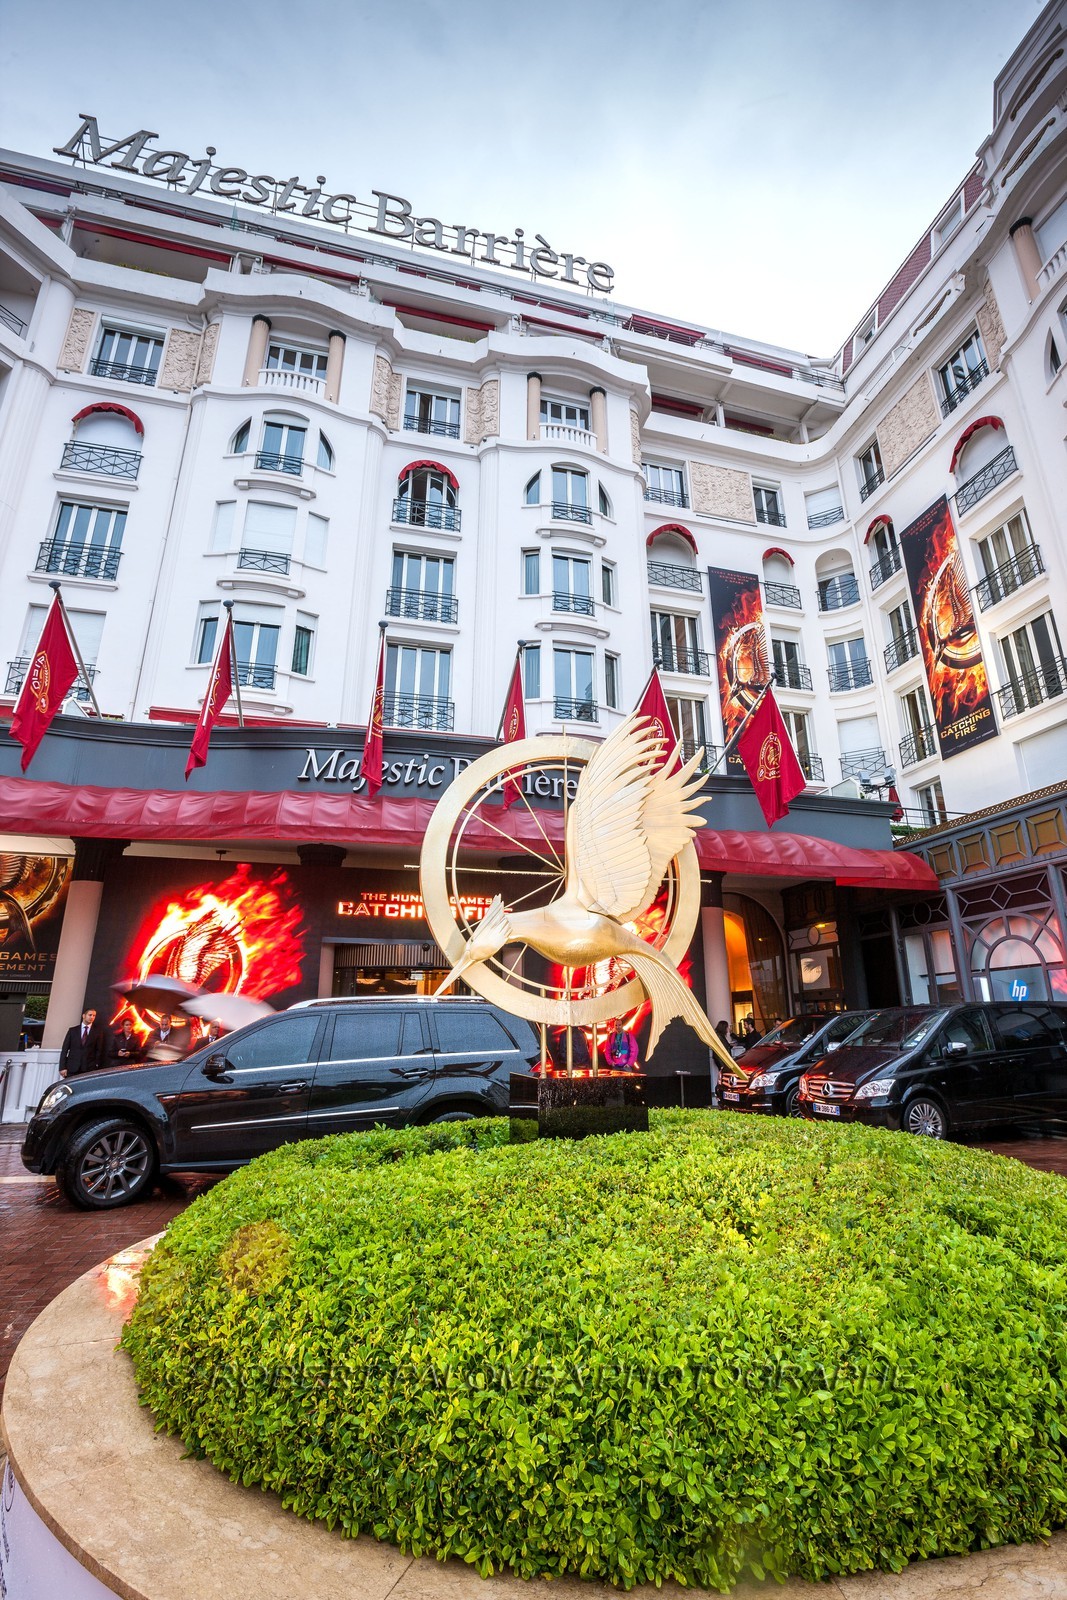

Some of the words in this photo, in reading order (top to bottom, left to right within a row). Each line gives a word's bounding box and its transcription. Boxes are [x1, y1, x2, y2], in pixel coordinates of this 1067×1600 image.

[52, 113, 357, 222] Majestic
[367, 190, 615, 293] Barrière
[940, 708, 991, 739] CATCHING
[954, 723, 978, 740] FIRE
[360, 892, 387, 901] THE
[391, 893, 423, 902] HUN
[337, 902, 457, 919] CATCHI
[1011, 979, 1027, 1001] hp
